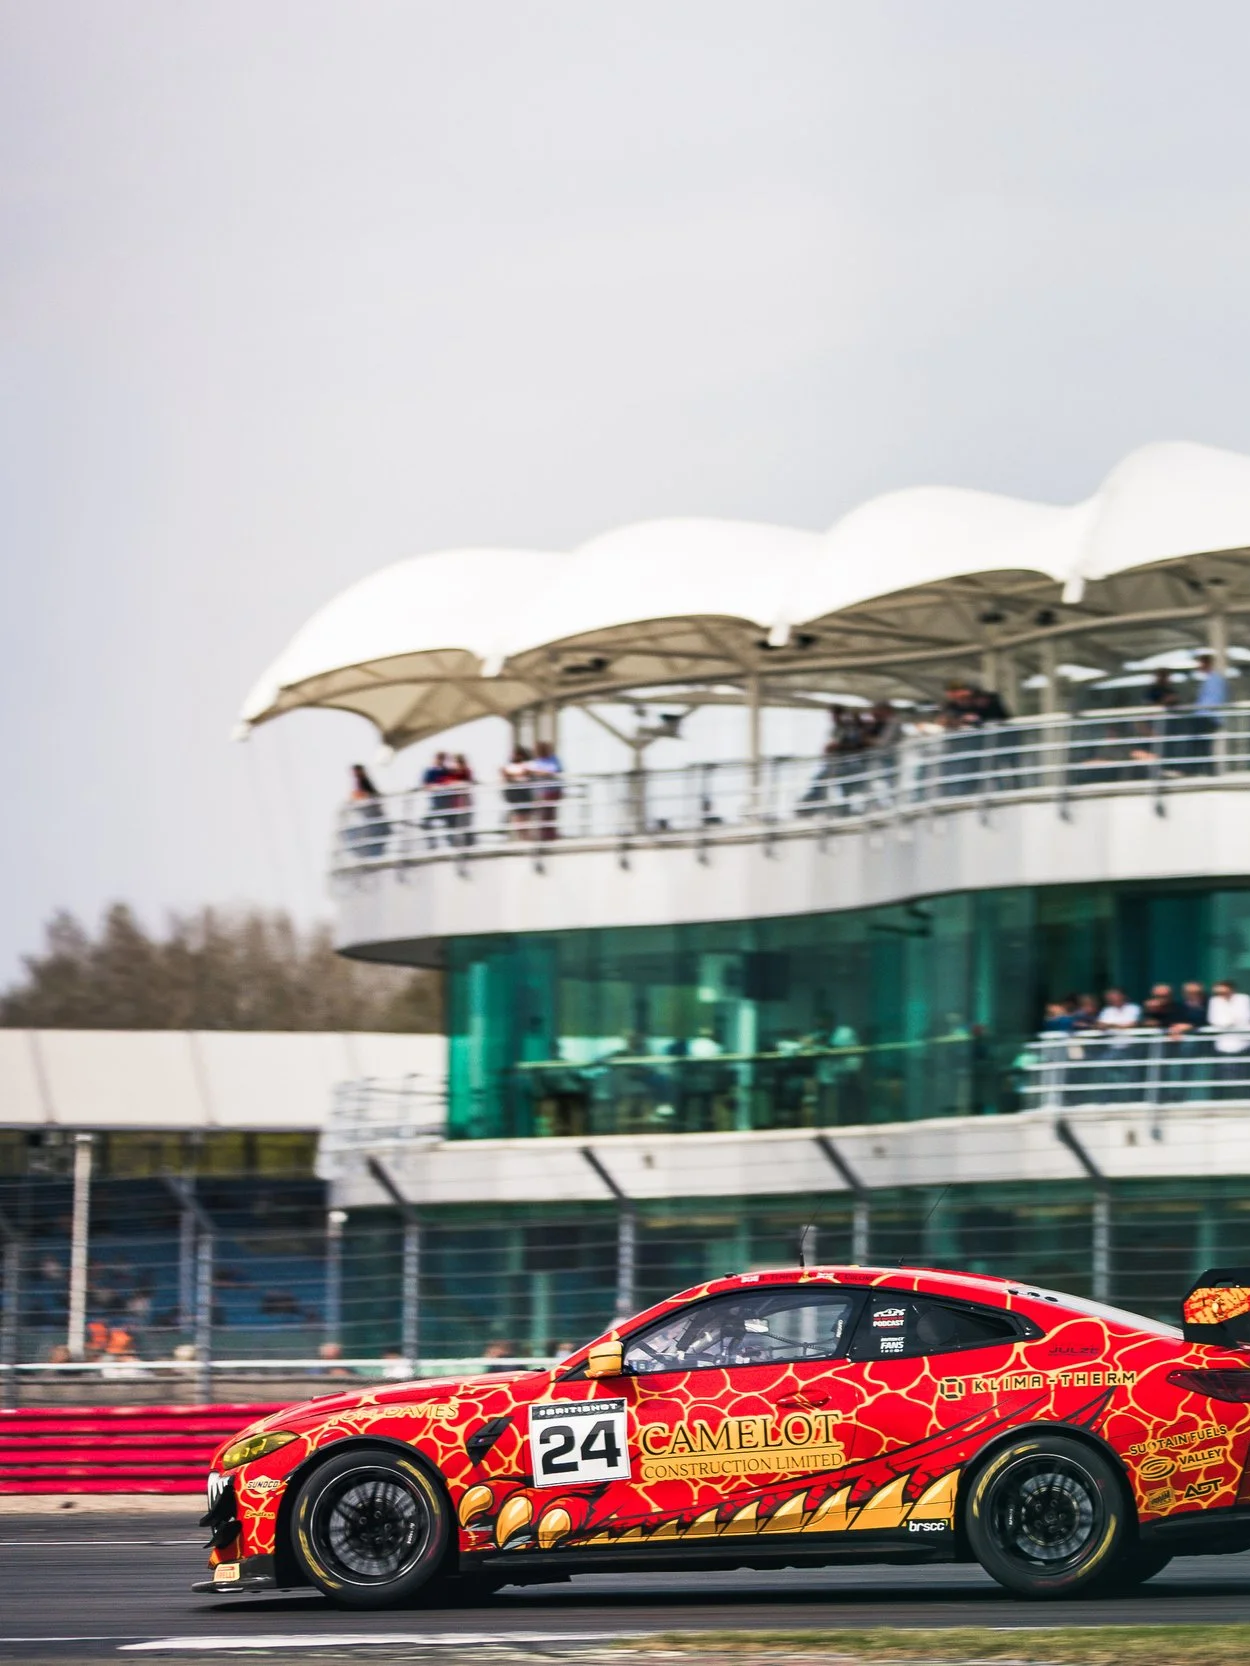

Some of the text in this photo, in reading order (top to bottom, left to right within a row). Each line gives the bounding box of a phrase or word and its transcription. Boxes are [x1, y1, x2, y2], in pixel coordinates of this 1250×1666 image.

[880, 1341, 905, 1350] FANS
[974, 1372, 1135, 1392] KLIMA-THERM
[385, 1404, 460, 1418] DAVIES
[642, 1413, 840, 1456] CAMELOT
[1190, 1425, 1228, 1441] FUELS
[539, 1420, 622, 1475] 24
[1179, 1448, 1222, 1465] VALLEY
[644, 1454, 843, 1479] CONSTRUCTION LIMITED
[247, 1480, 280, 1489] SUNOCO
[908, 1520, 945, 1532] brscc
